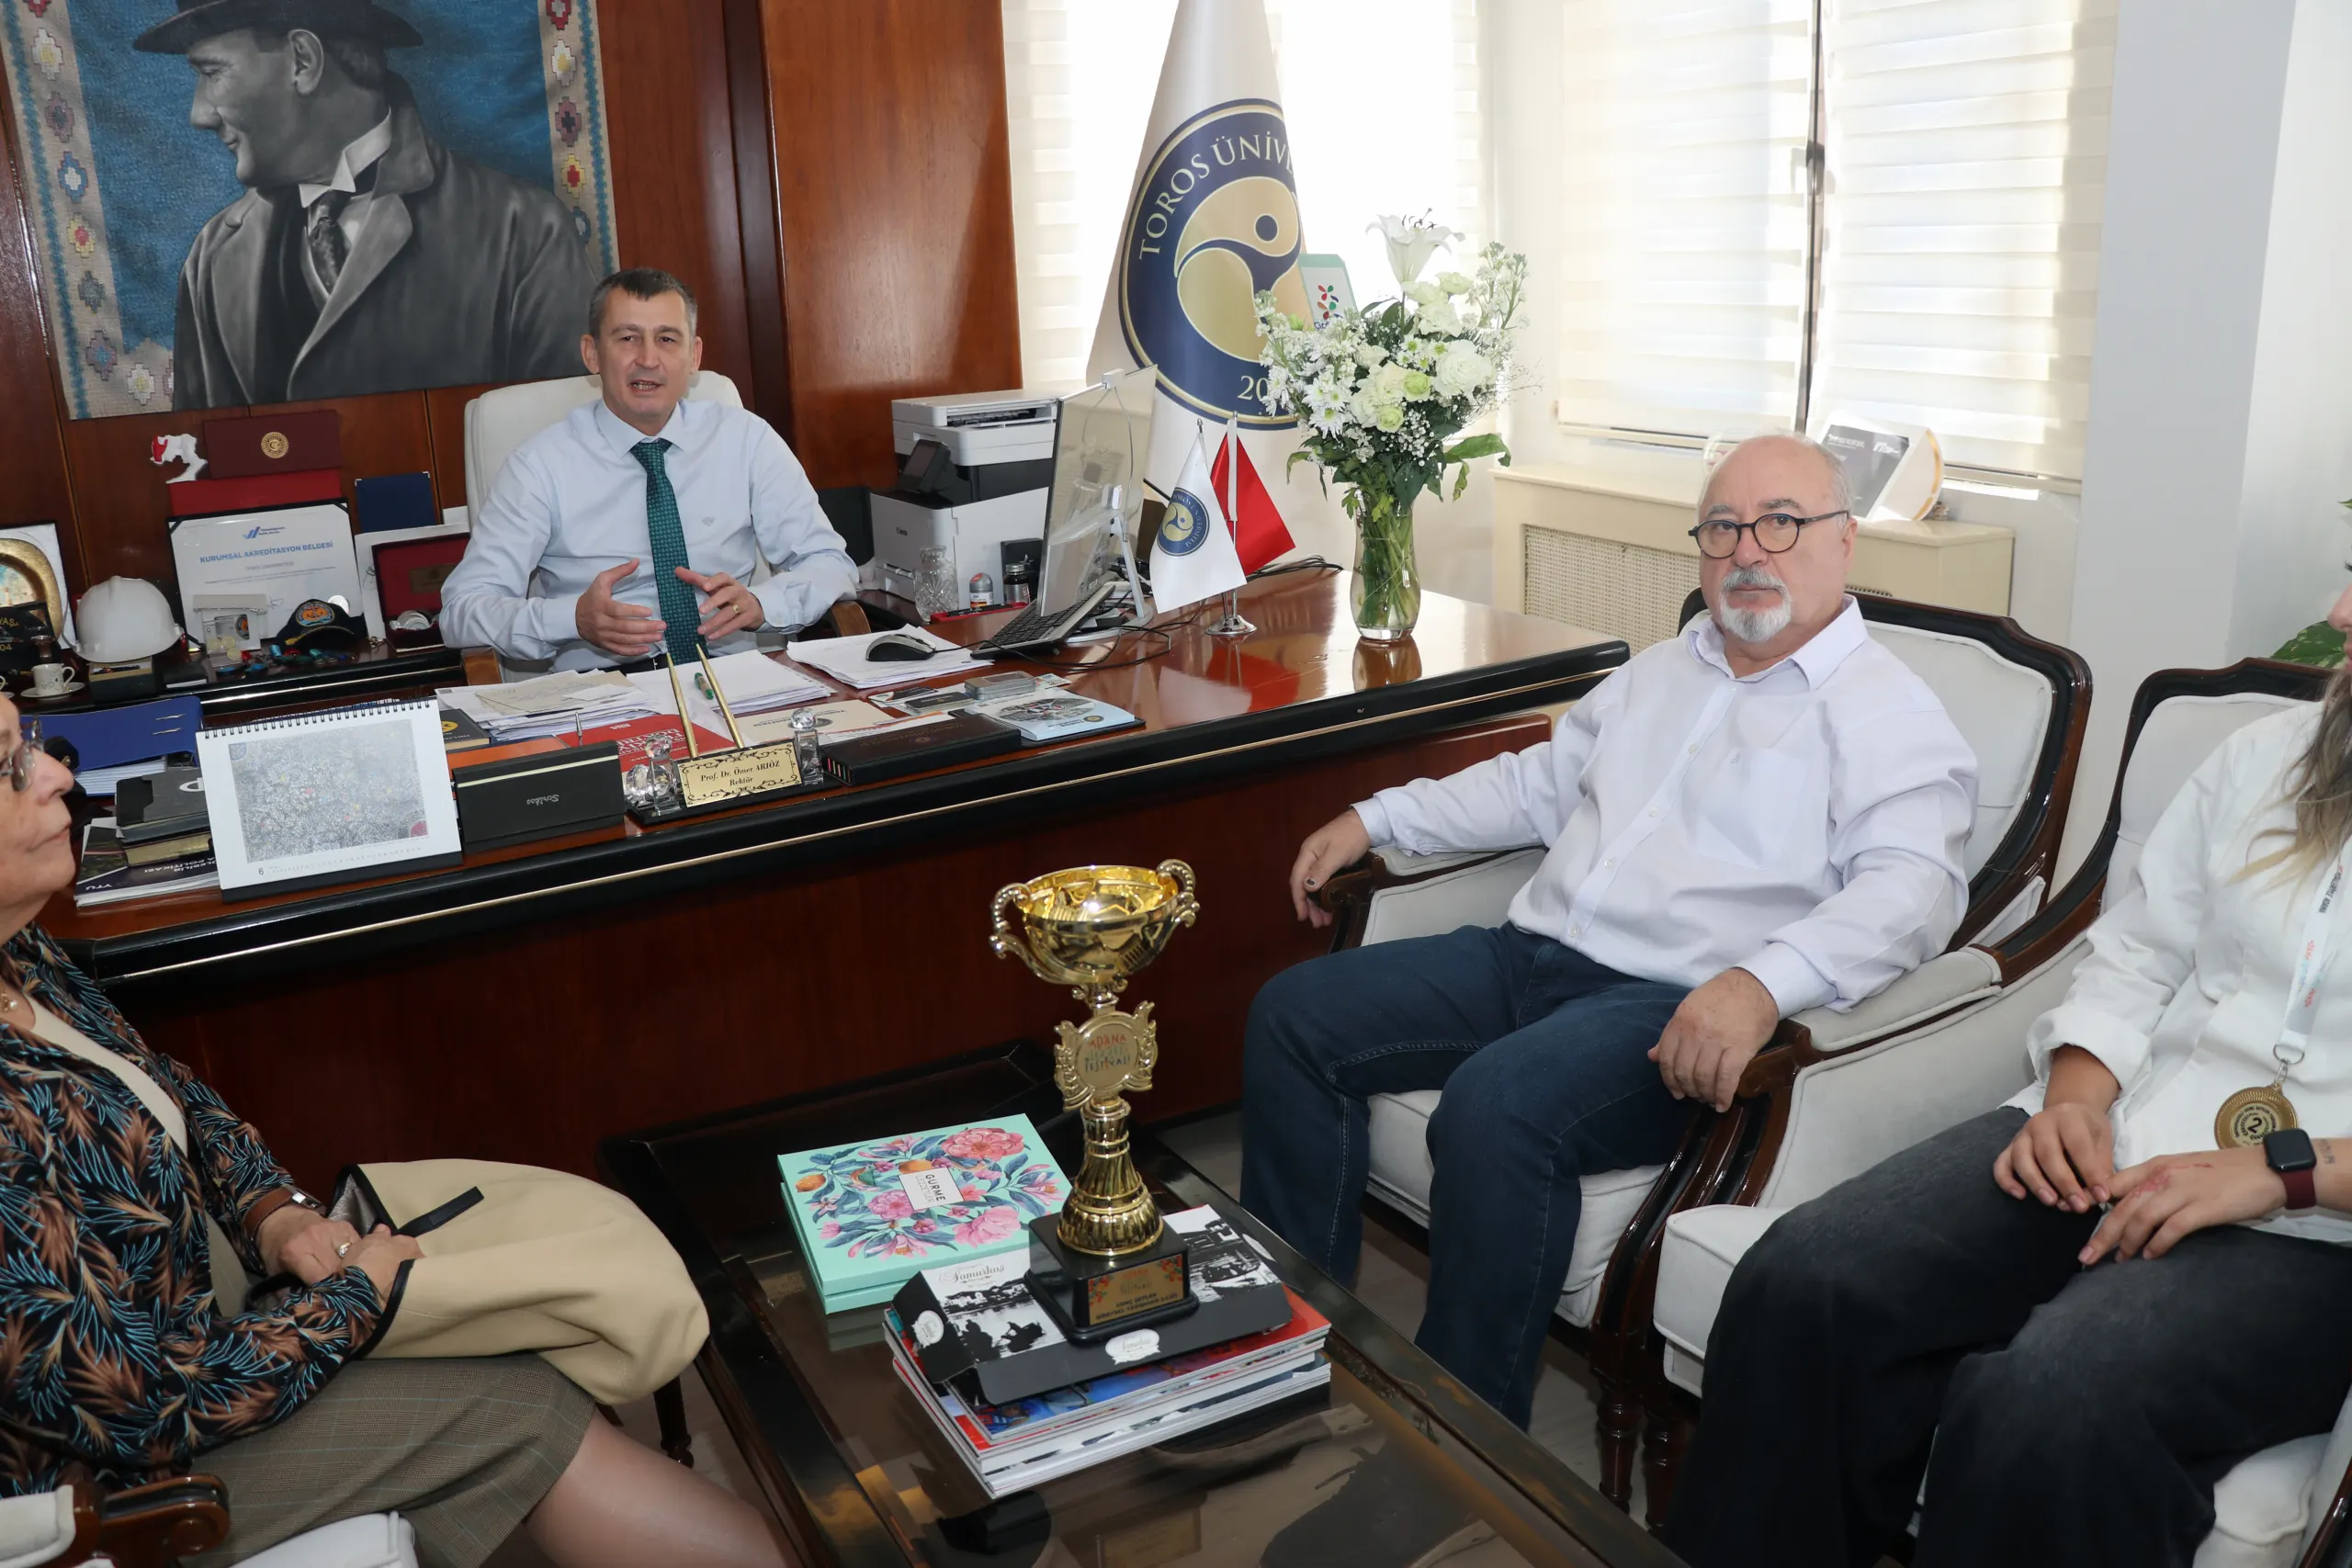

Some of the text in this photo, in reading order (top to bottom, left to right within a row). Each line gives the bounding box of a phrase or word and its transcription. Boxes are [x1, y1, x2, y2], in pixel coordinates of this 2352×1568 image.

[1139, 152, 1210, 260] TOROS
[199, 541, 334, 563] KURUMSAL AKREDİTASYON BELGESİ
[700, 773, 718, 782] Prof.
[734, 767, 753, 775] Ömer
[755, 760, 780, 771] ARIÖZ
[729, 778, 753, 786] Rektör
[1088, 1034, 1126, 1050] ADANA
[2246, 1116, 2263, 1134] 2
[925, 1173, 946, 1201] GURME
